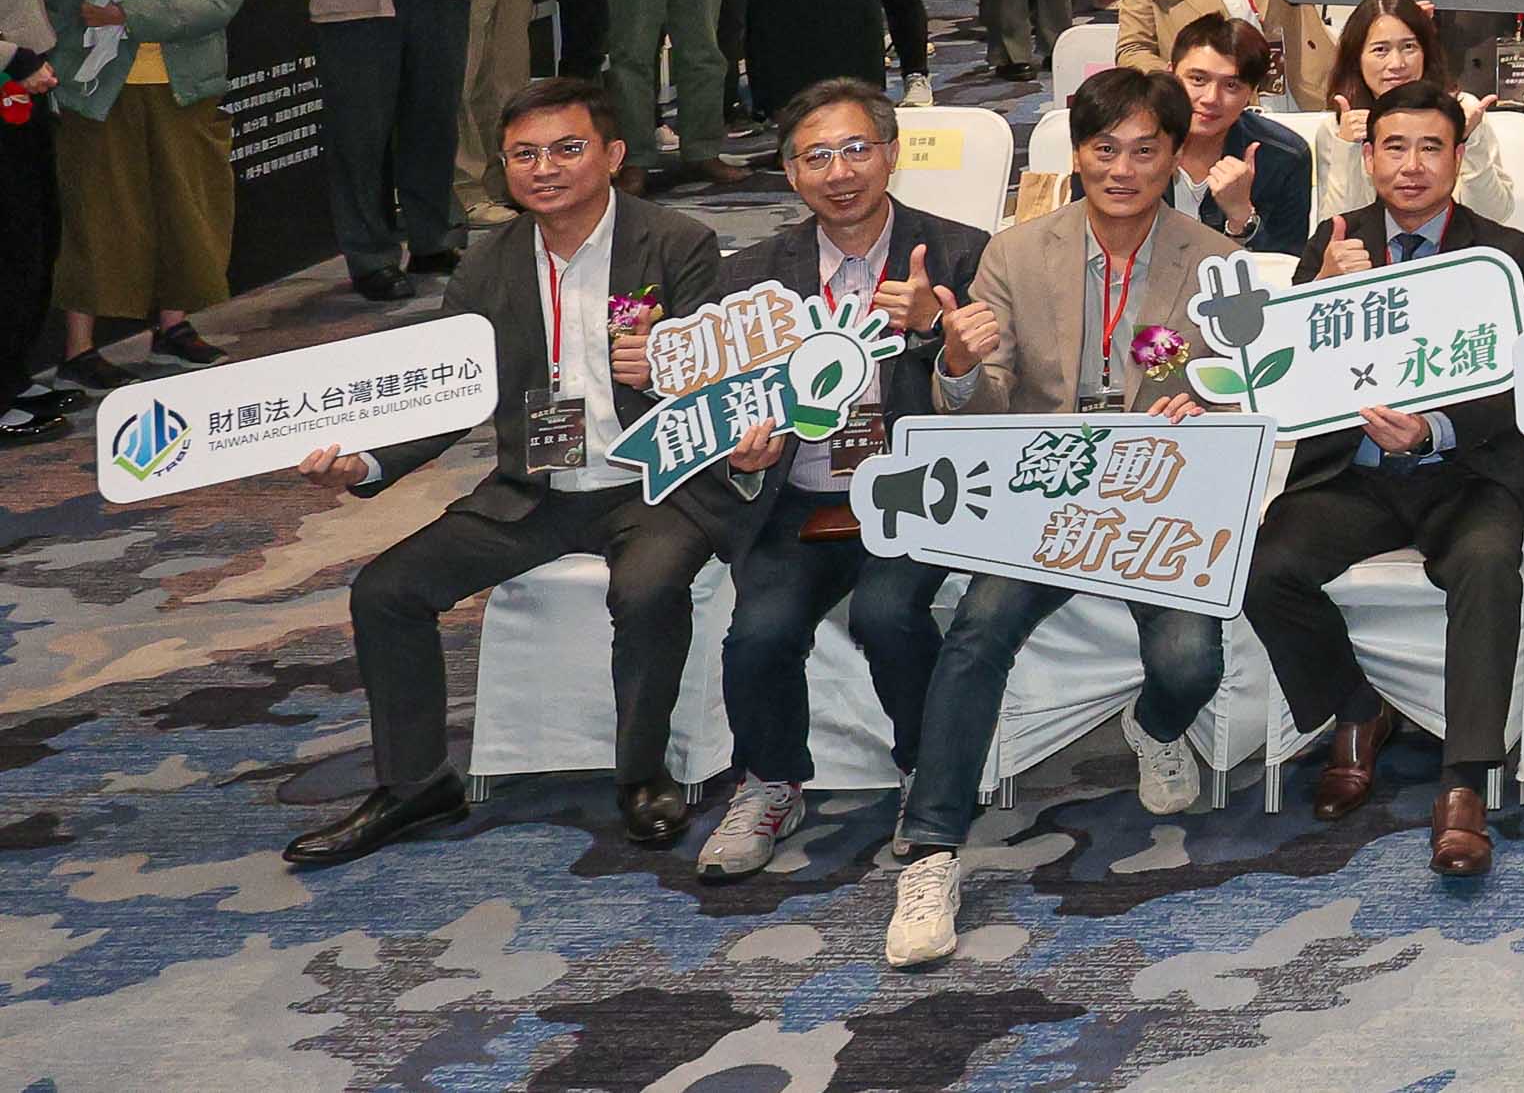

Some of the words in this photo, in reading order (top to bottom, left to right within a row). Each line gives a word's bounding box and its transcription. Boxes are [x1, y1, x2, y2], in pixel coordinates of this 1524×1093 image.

[1306, 287, 1410, 352] 節能
[1397, 322, 1499, 389] 永續
[208, 357, 483, 436] 財團法人台灣建築中心
[208, 430, 261, 451] TAIWAN
[262, 409, 357, 441] ARCHITECTURE
[359, 406, 370, 419] &
[372, 393, 433, 417] BUILDING
[434, 382, 483, 405] CENTER
[651, 367, 788, 475] 創新
[1008, 430, 1187, 503] 綠動
